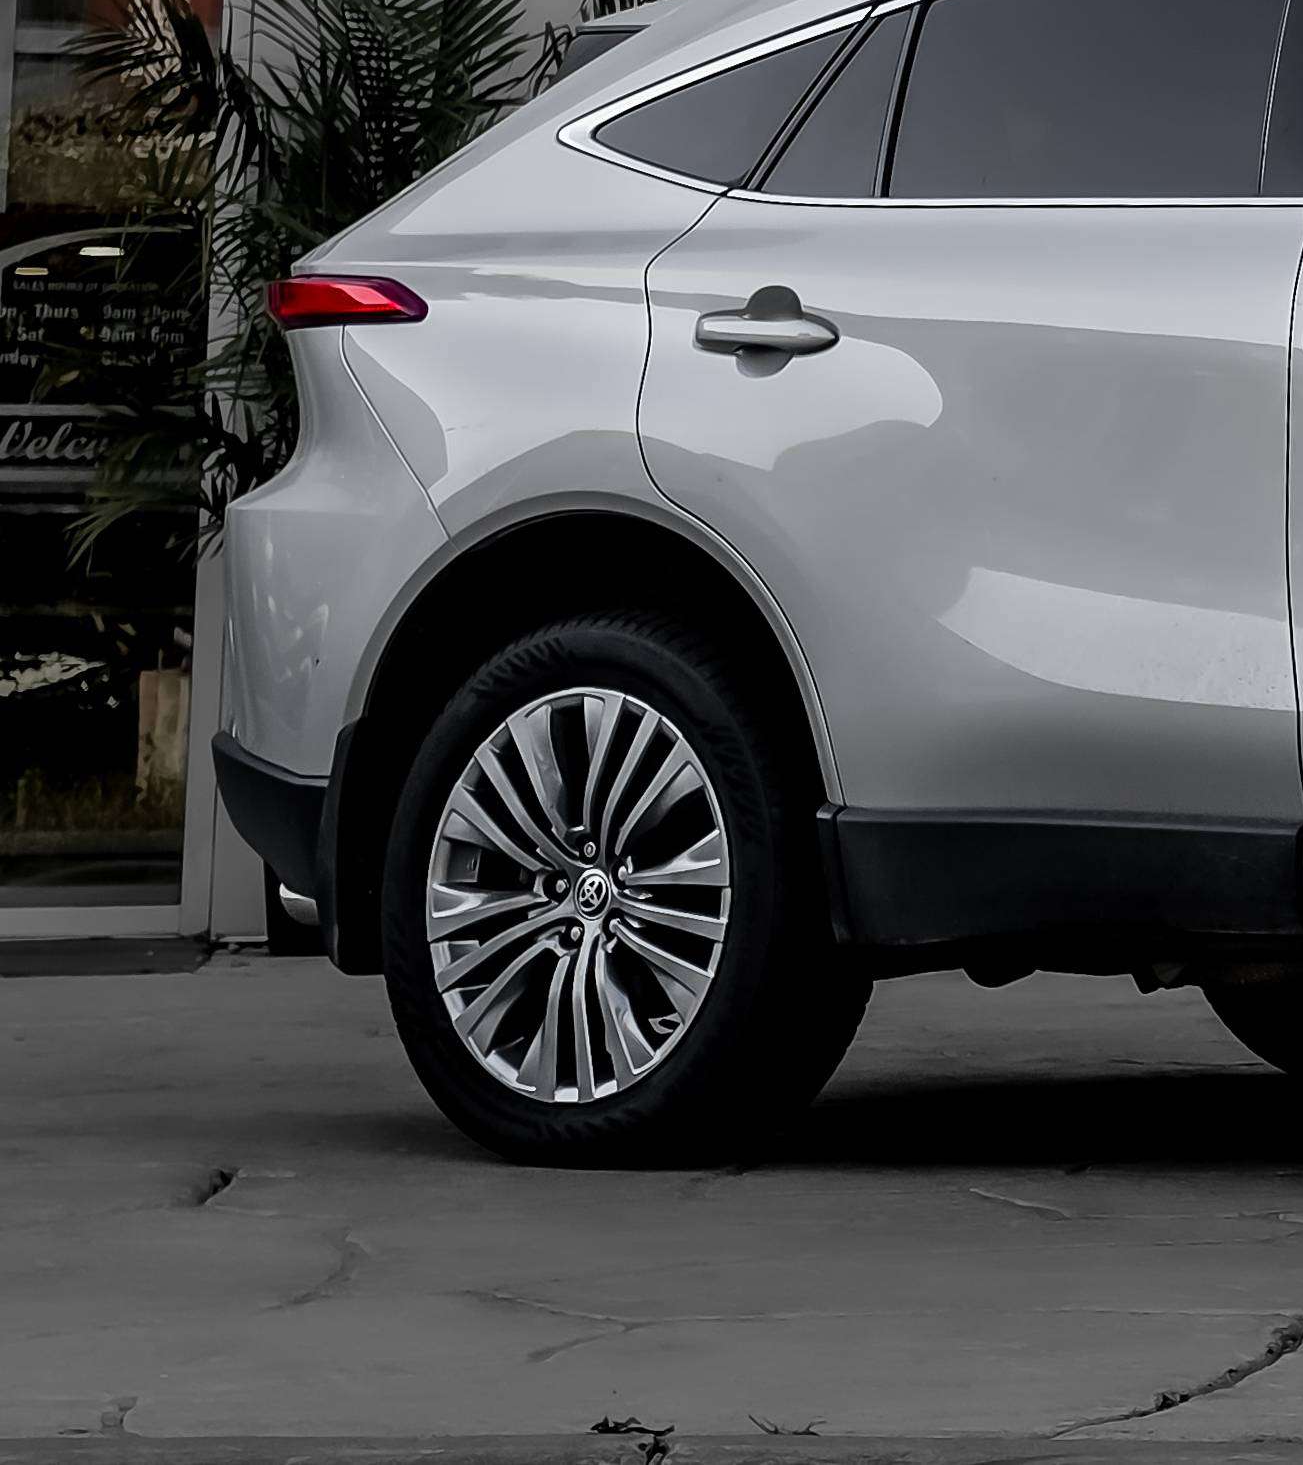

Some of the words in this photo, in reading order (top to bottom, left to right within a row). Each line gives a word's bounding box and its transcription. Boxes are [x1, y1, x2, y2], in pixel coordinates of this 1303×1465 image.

[34, 303, 80, 320] Thurs
[102, 304, 137, 320] 9am
[17, 325, 45, 342] Sat
[0, 347, 39, 368] nday
